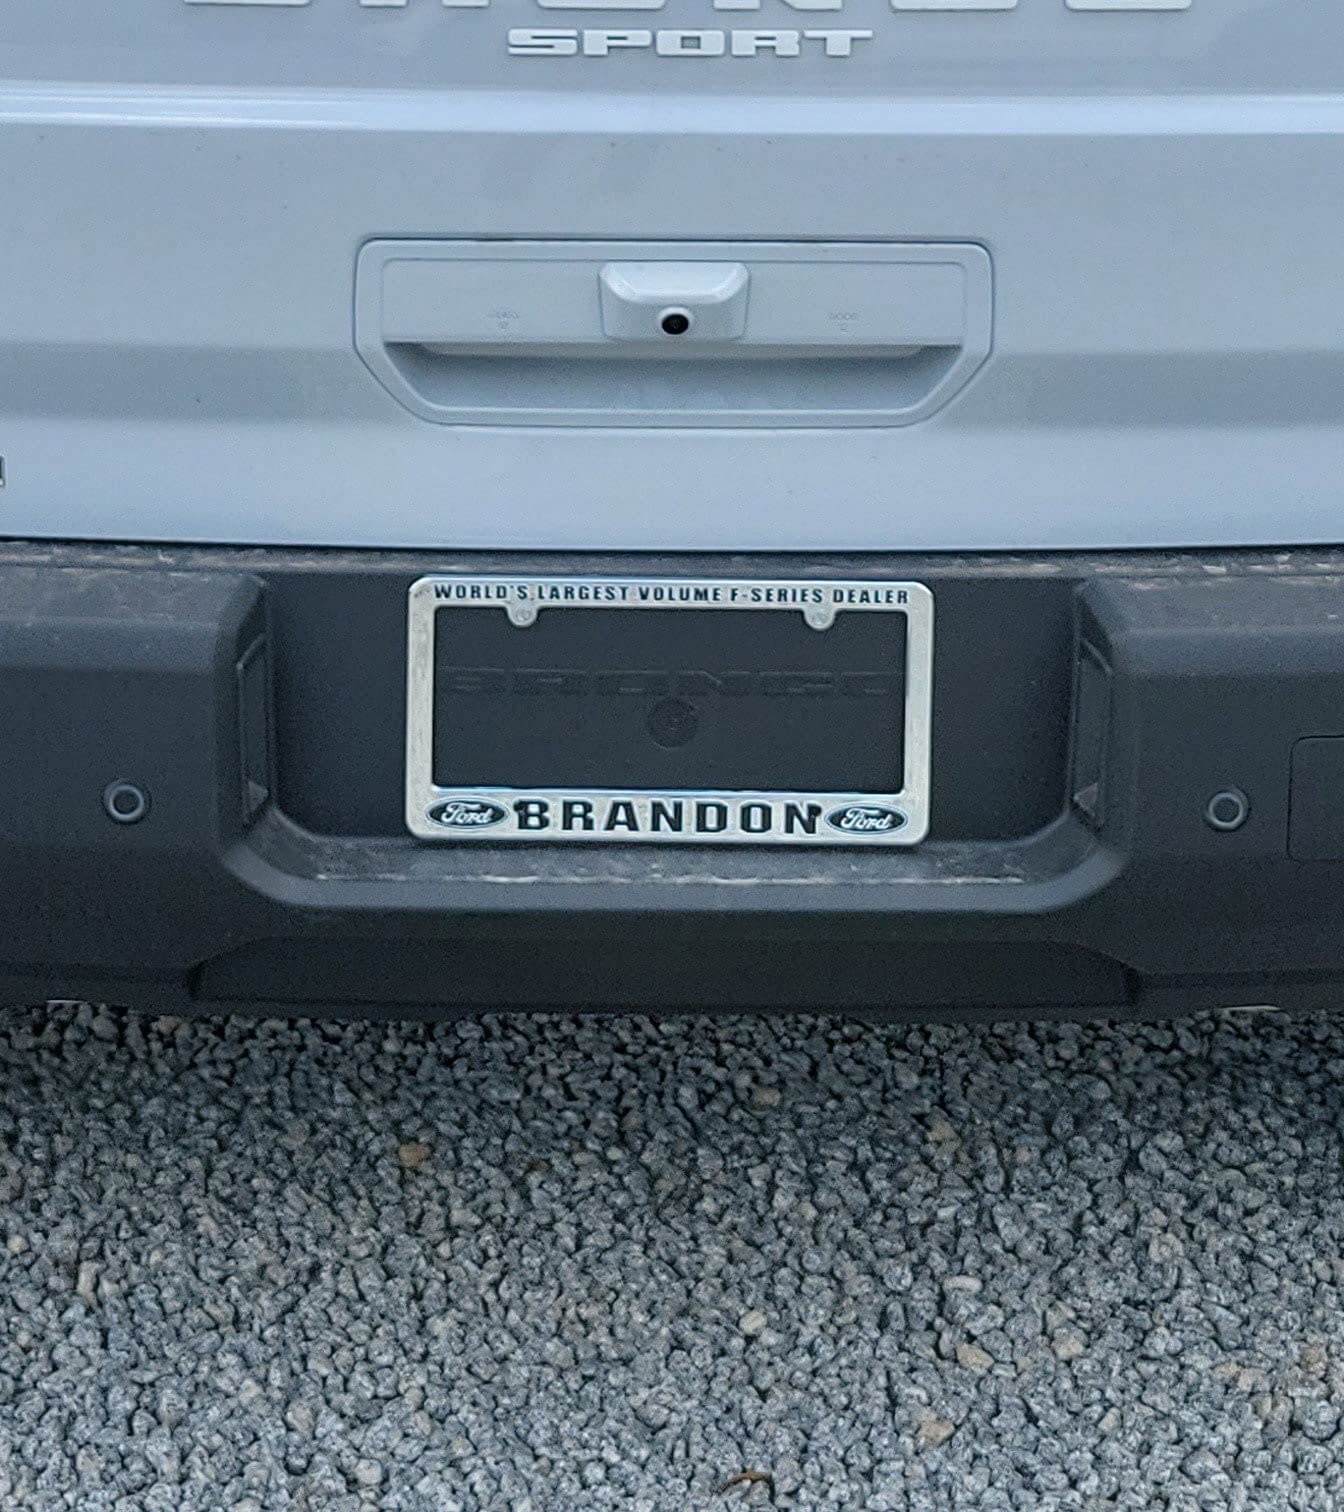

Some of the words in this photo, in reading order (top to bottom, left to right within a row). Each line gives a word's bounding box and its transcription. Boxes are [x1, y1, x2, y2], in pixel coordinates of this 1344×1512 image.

[507, 28, 874, 58] SPORT
[434, 584, 528, 600] WORLD'S
[538, 585, 629, 601] LARGEST
[639, 586, 721, 602] VOLUME
[730, 587, 824, 603] F-SERIES
[833, 589, 908, 604] DEALER
[440, 800, 497, 826] Ford
[514, 799, 822, 834] BRANDON
[840, 806, 894, 832] Ford
